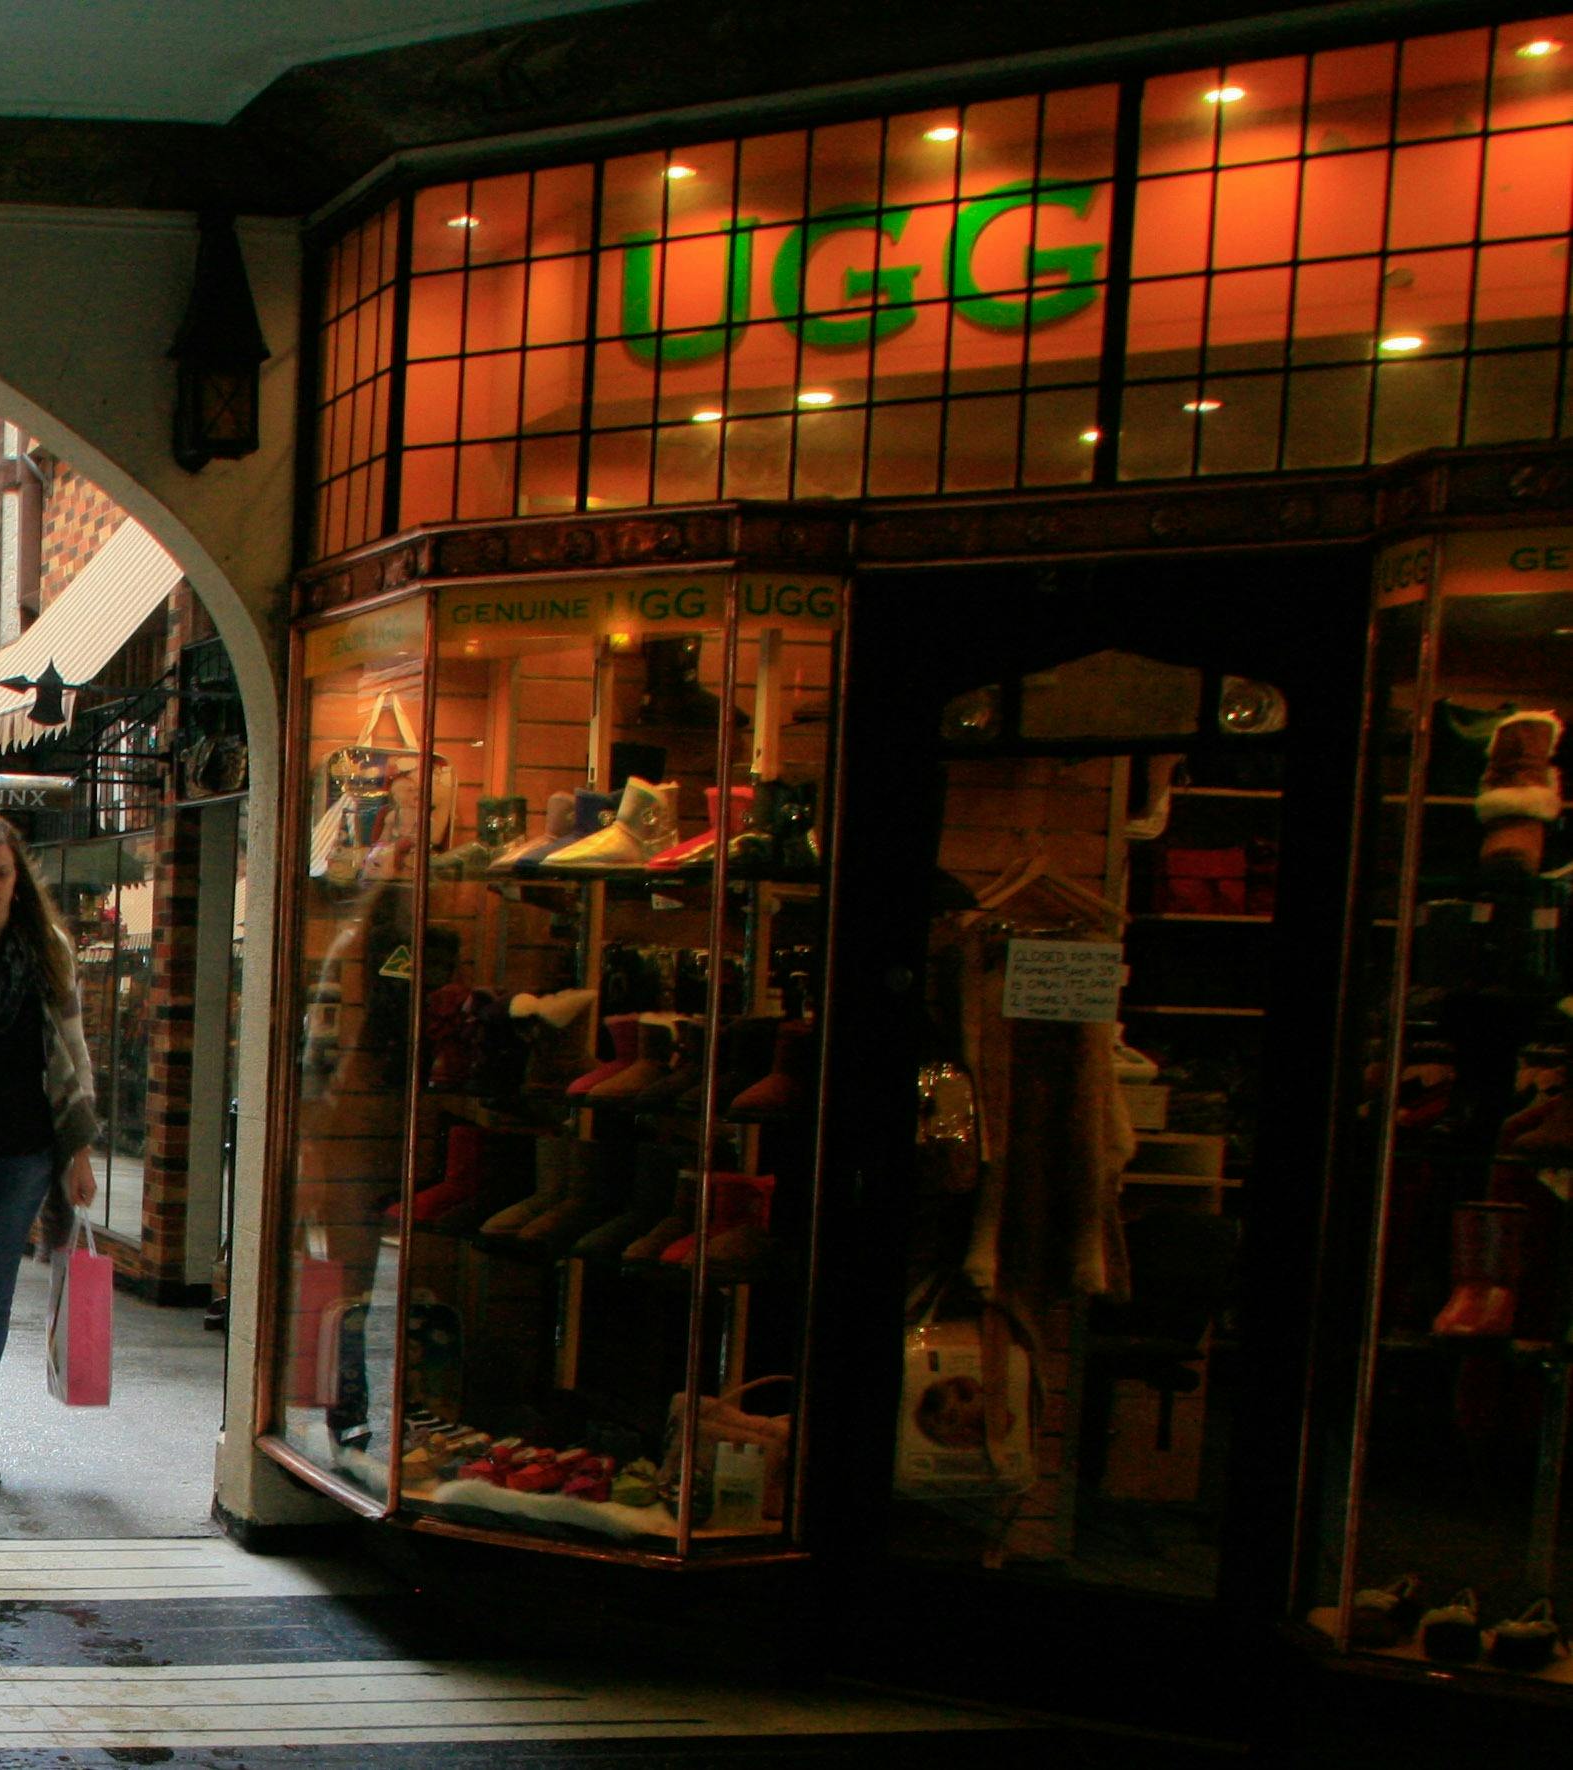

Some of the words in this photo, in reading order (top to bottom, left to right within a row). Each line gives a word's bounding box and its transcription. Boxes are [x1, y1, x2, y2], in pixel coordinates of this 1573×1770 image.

[620, 178, 1103, 366] UGG
[453, 599, 589, 625] GENUINE
[607, 587, 707, 620] UGG
[743, 584, 838, 619] UGG
